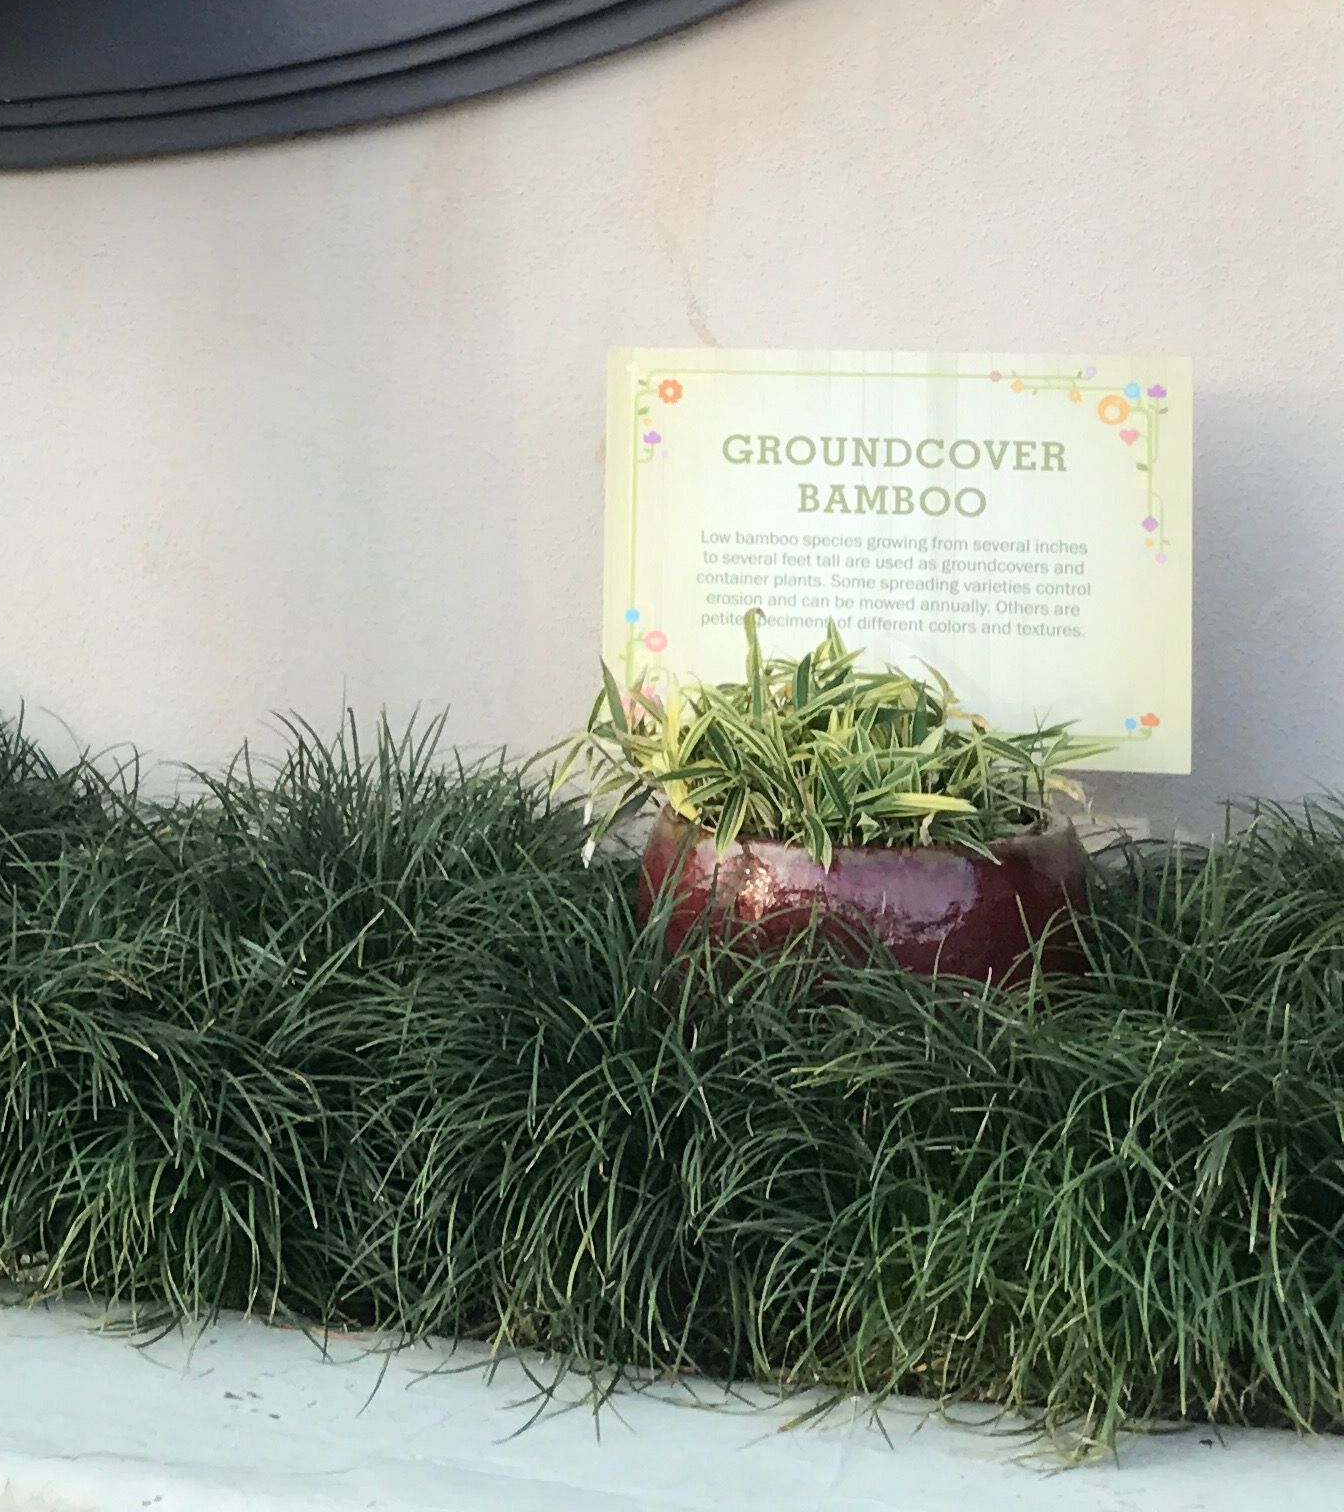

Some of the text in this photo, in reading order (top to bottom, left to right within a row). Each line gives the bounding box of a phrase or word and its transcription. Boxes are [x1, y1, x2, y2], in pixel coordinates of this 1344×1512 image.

[722, 434, 1067, 472] GROUNDCOVER
[797, 483, 987, 518] BAMBOO
[701, 531, 1088, 554] Low bamboo species growing from several inches
[703, 552, 1085, 576] to several feet tall are used as groundcovers and
[696, 573, 1092, 596] container plants. Some spreading varieties control
[706, 593, 1081, 616] erosion and can be mowed annually. Others are
[700, 614, 1086, 636] petite pecimen of different colors and textures.
